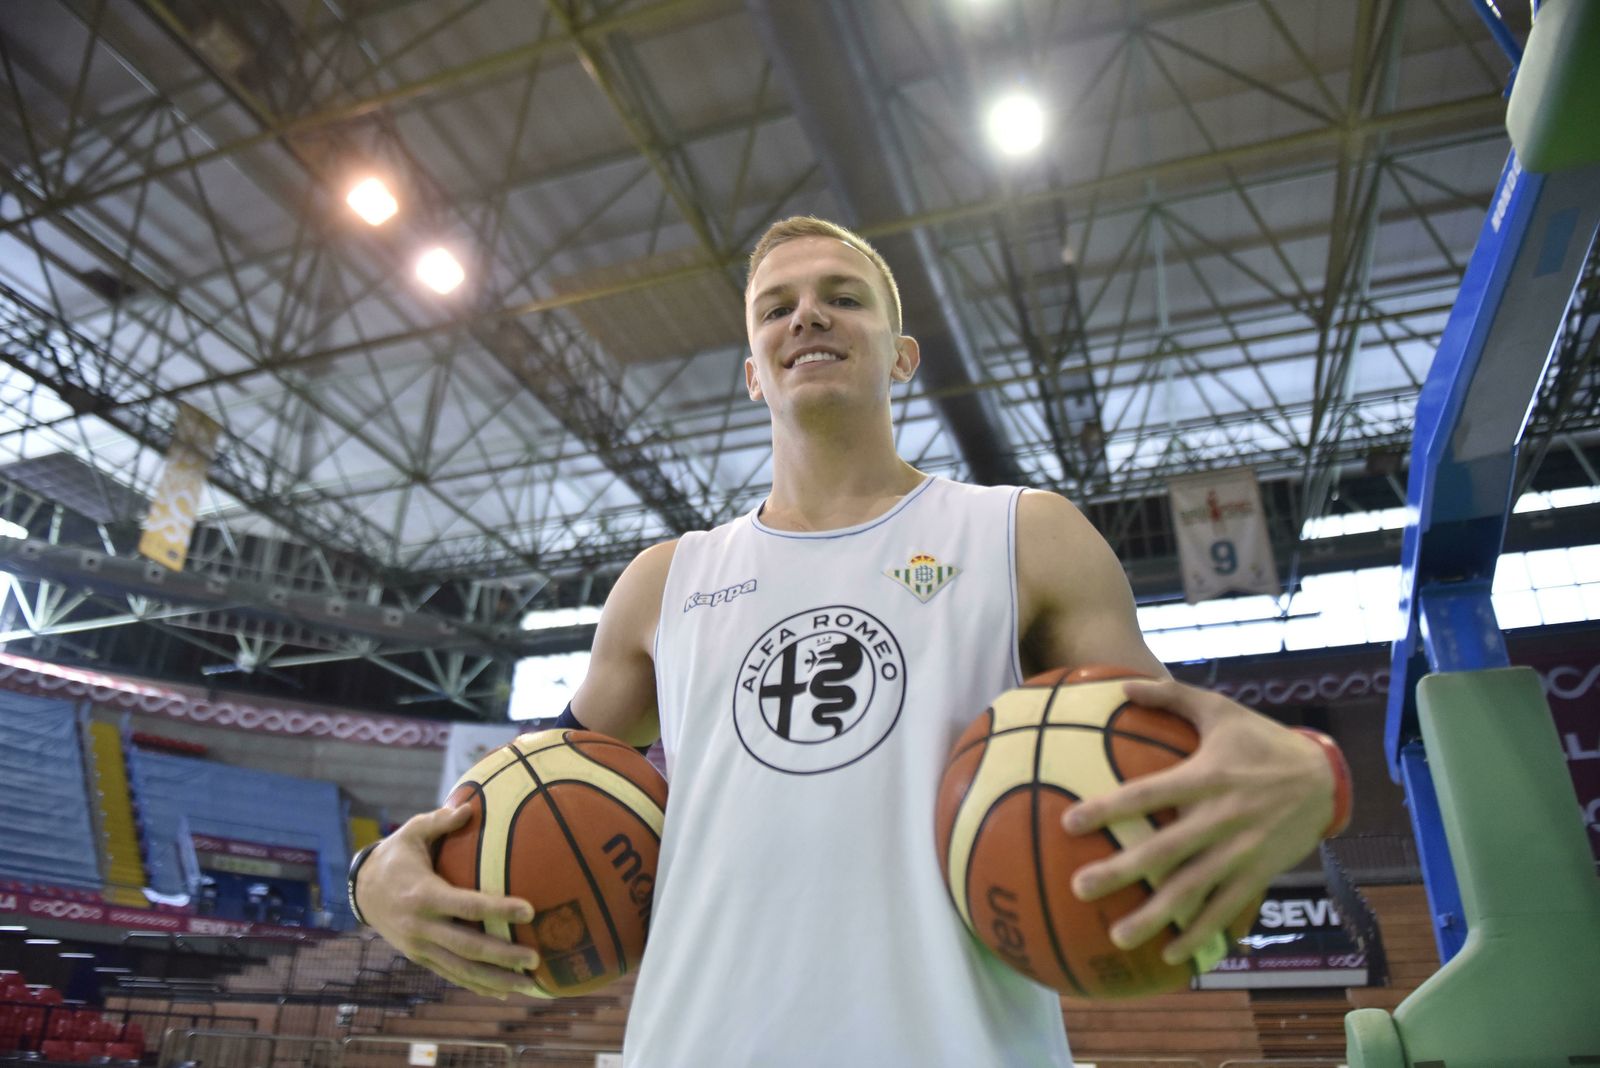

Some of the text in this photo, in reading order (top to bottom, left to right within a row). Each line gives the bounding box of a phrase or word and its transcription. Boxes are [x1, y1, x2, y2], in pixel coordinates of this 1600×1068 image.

[1210, 540, 1239, 576] 9
[683, 579, 757, 613] Kappa
[742, 613, 897, 693] ALFA ROMEO
